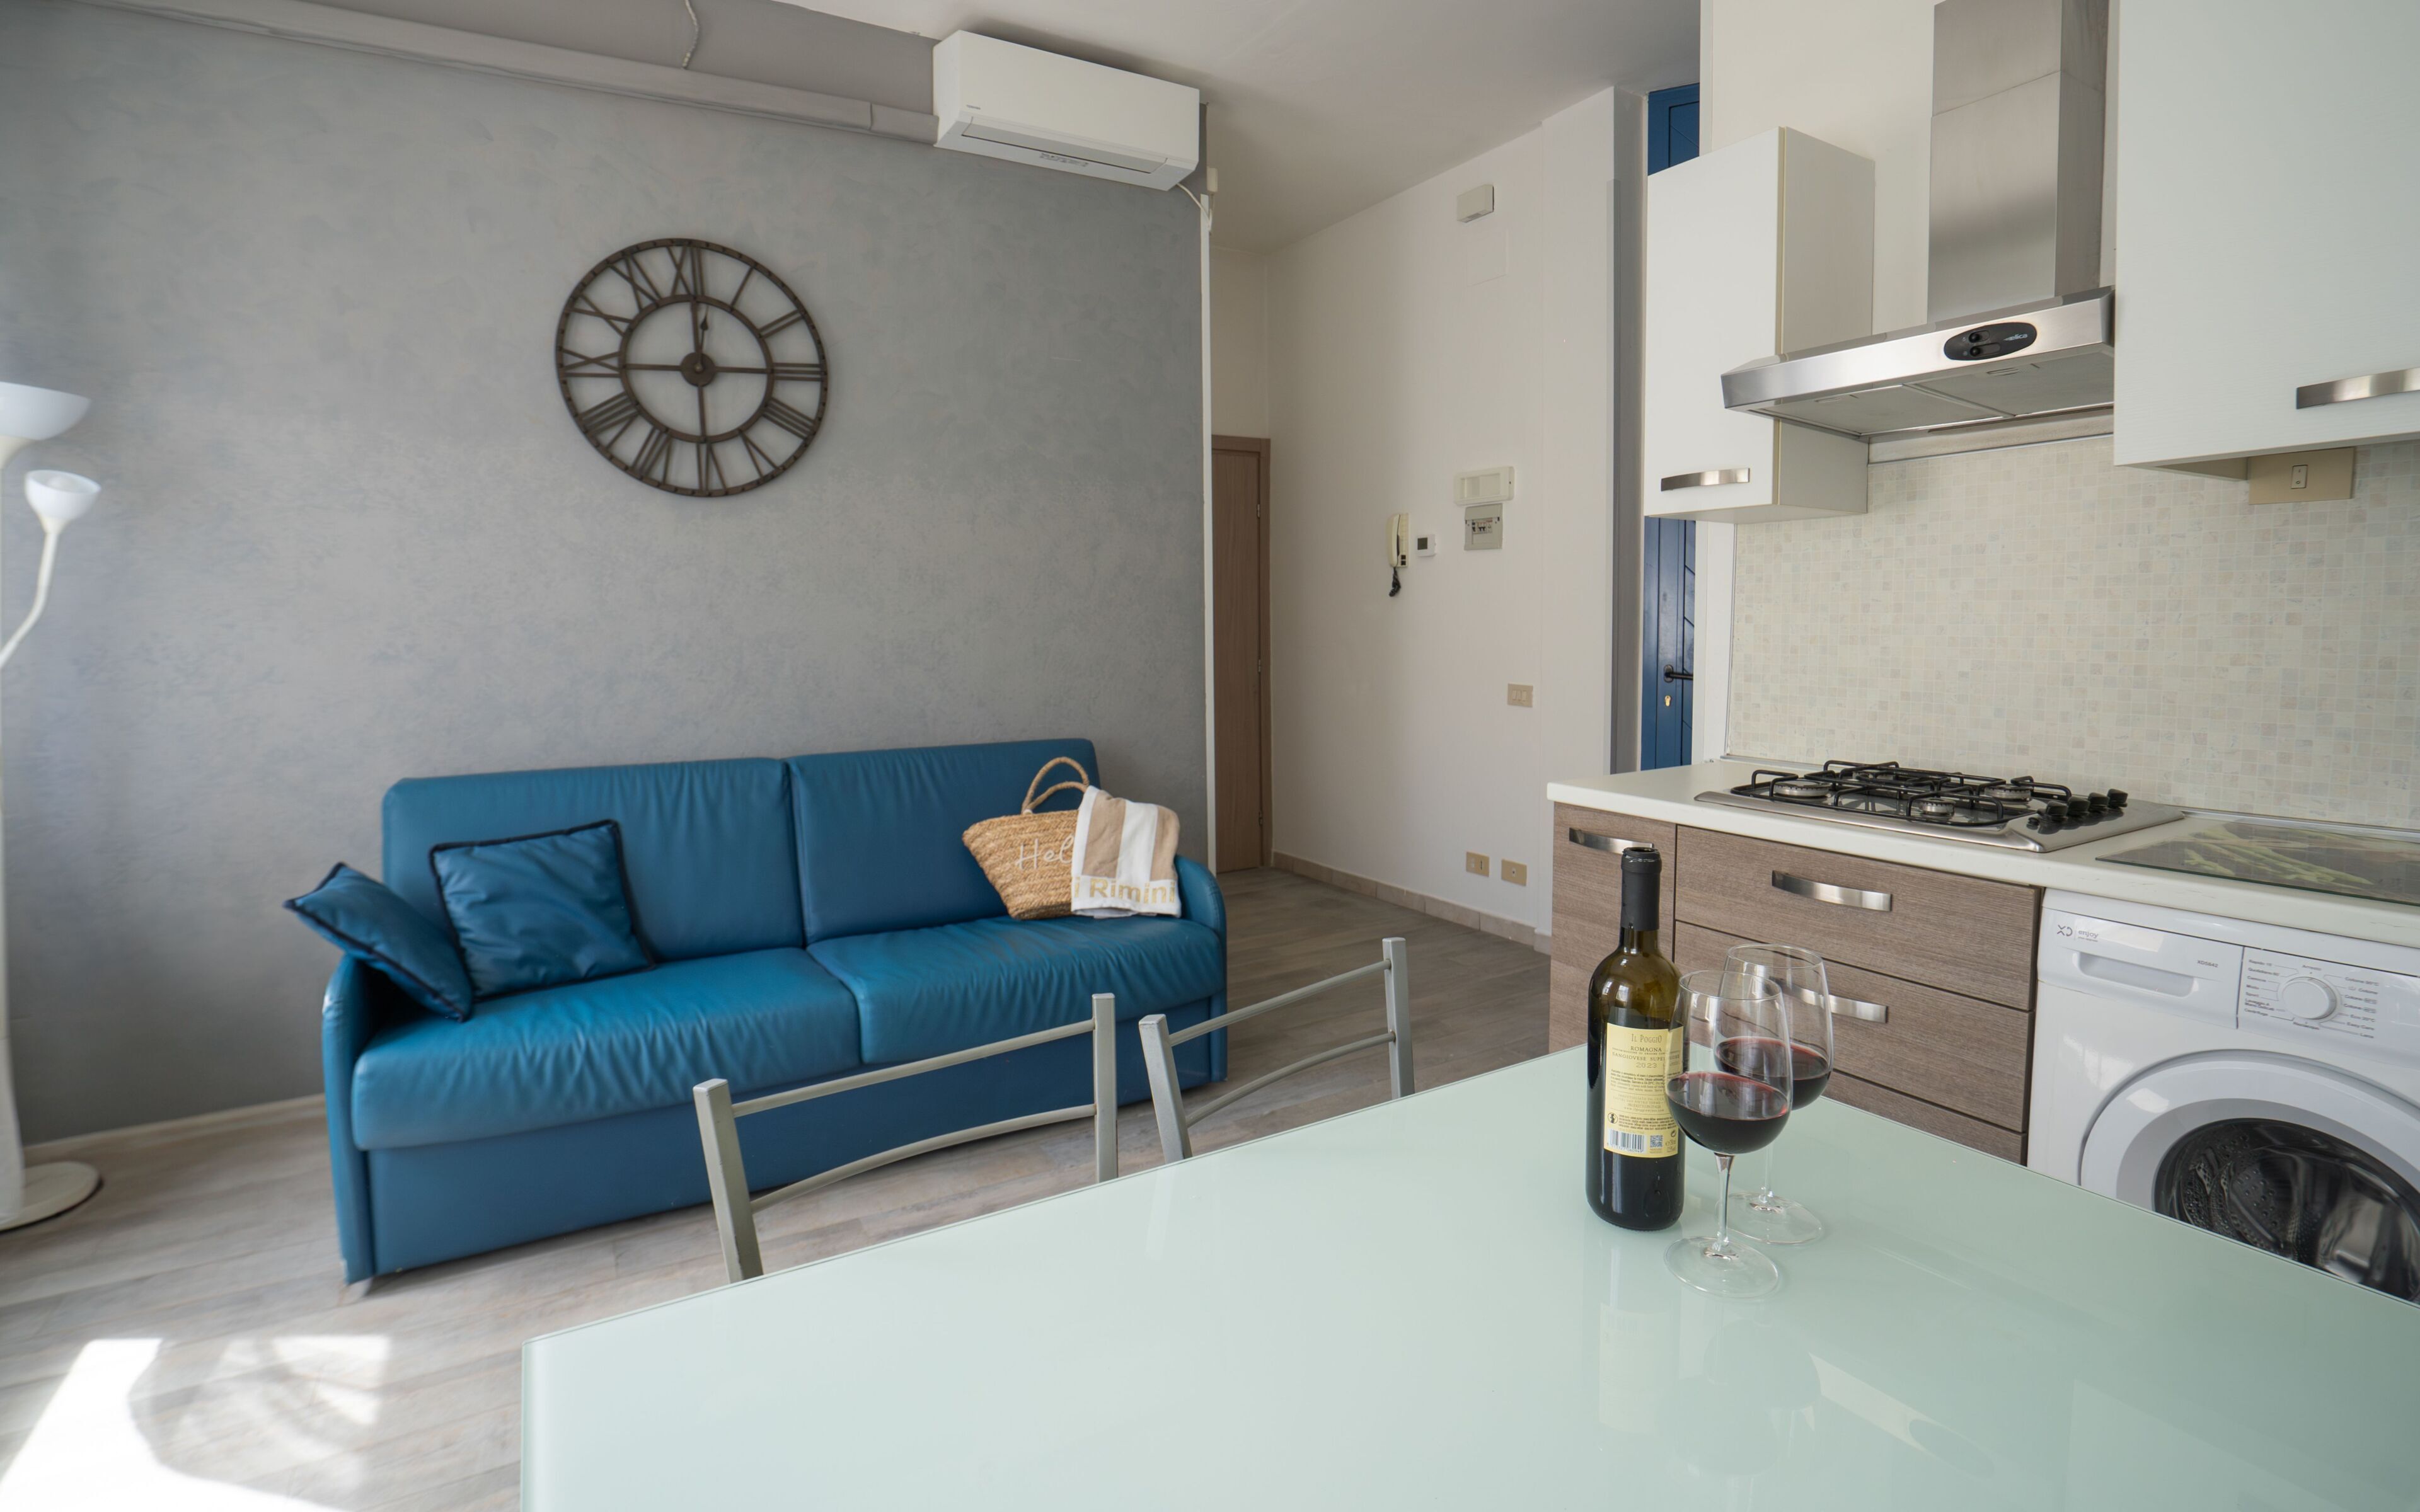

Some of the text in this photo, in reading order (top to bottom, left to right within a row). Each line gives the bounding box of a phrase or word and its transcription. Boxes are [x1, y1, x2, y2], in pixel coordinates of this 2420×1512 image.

[1015, 835, 1073, 870] Hel
[1090, 877, 1176, 904] Rimini
[2078, 930, 2099, 939] enjoy
[1612, 1052, 1646, 1061] SANGIOVESE
